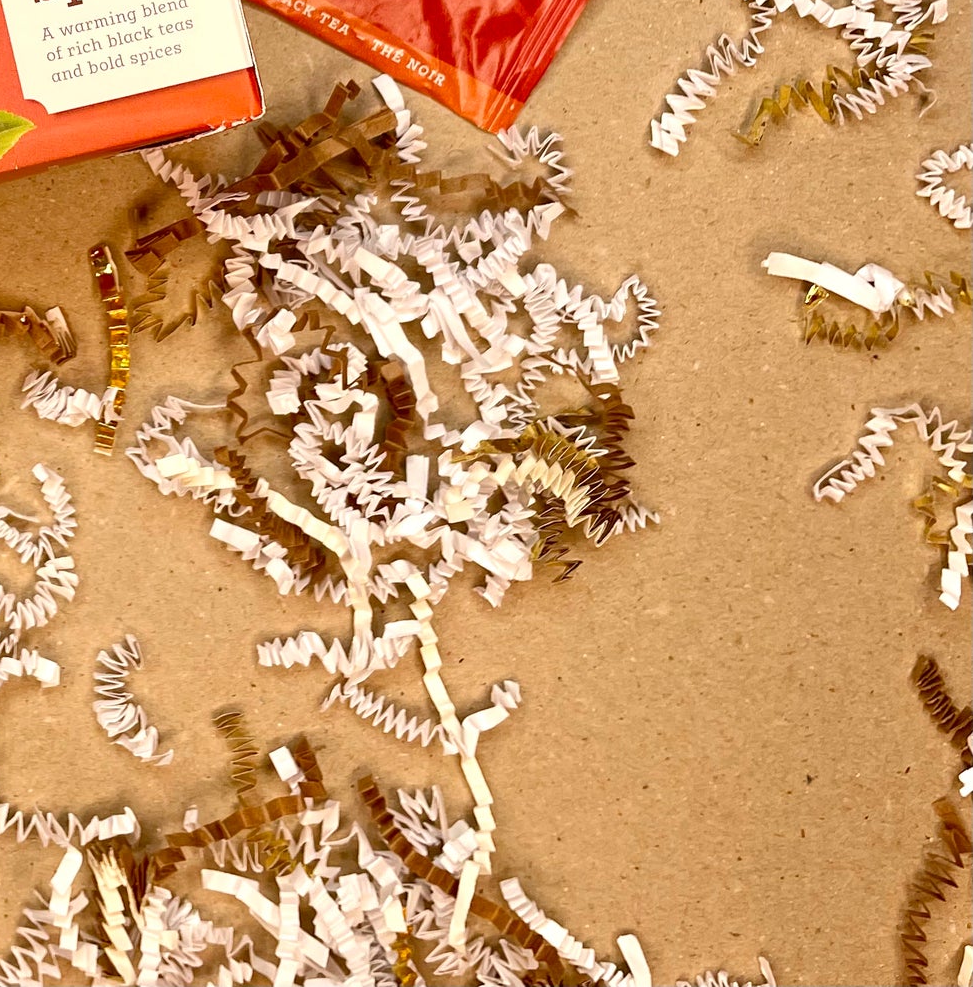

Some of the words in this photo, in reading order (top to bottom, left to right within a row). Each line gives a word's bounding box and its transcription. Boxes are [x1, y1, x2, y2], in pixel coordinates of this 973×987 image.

[42, 26, 54, 41] A
[59, 9, 137, 37] warming
[46, 46, 63, 62] of
[67, 38, 103, 57] rich
[107, 26, 153, 48] black
[158, 19, 194, 36] teas
[51, 64, 84, 83] and
[88, 54, 125, 75] bold
[130, 43, 182, 66] spices
[319, 13, 350, 36] TEA
[370, 38, 404, 64] THÉ
[406, 57, 446, 87] NOIR
